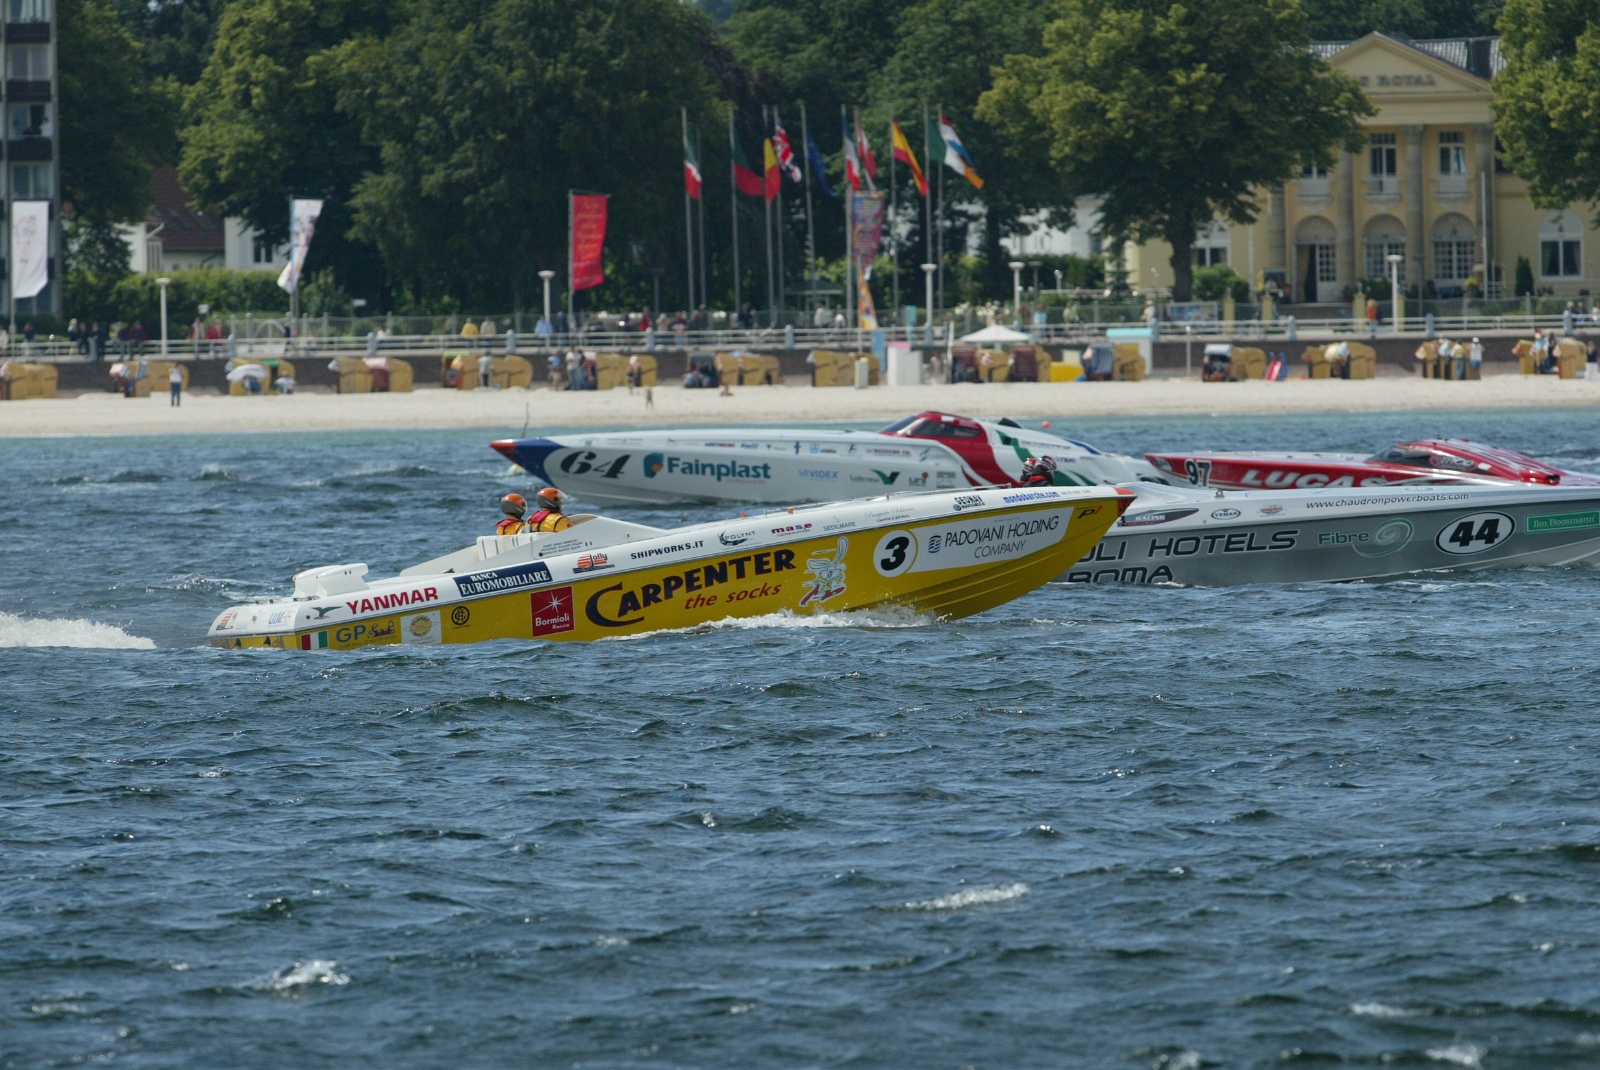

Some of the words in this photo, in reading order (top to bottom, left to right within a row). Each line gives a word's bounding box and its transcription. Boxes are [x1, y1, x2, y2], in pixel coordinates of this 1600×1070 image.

[560, 450, 631, 479] 64
[667, 456, 772, 482] Fainplast
[1185, 459, 1212, 487] 97
[1003, 491, 1061, 504] mondobarche.com
[1306, 492, 1470, 509] www.chaudronpowerboats.com
[823, 521, 857, 531] SEDILMARE
[1135, 514, 1166, 522] RACING
[724, 530, 756, 540] POLYNT
[771, 523, 813, 534] mase
[944, 525, 1005, 547] PADOVANI
[1007, 516, 1060, 538] HOLDING
[1318, 531, 1370, 546] Fibre
[1448, 518, 1501, 547] 44
[630, 540, 705, 560] SHIPWORKS.IT
[880, 536, 910, 571] 3
[974, 540, 1028, 559] COMPANY
[1147, 529, 1299, 558] HOTELS
[459, 570, 550, 596] EUROMOBILIARE
[470, 572, 498, 582] BANCA
[585, 549, 797, 628] CARPENTER
[684, 594, 718, 610] the
[725, 582, 782, 604] socks
[346, 586, 439, 615] YANMAR
[535, 612, 570, 627] Bormioli
[336, 625, 366, 643] GP
